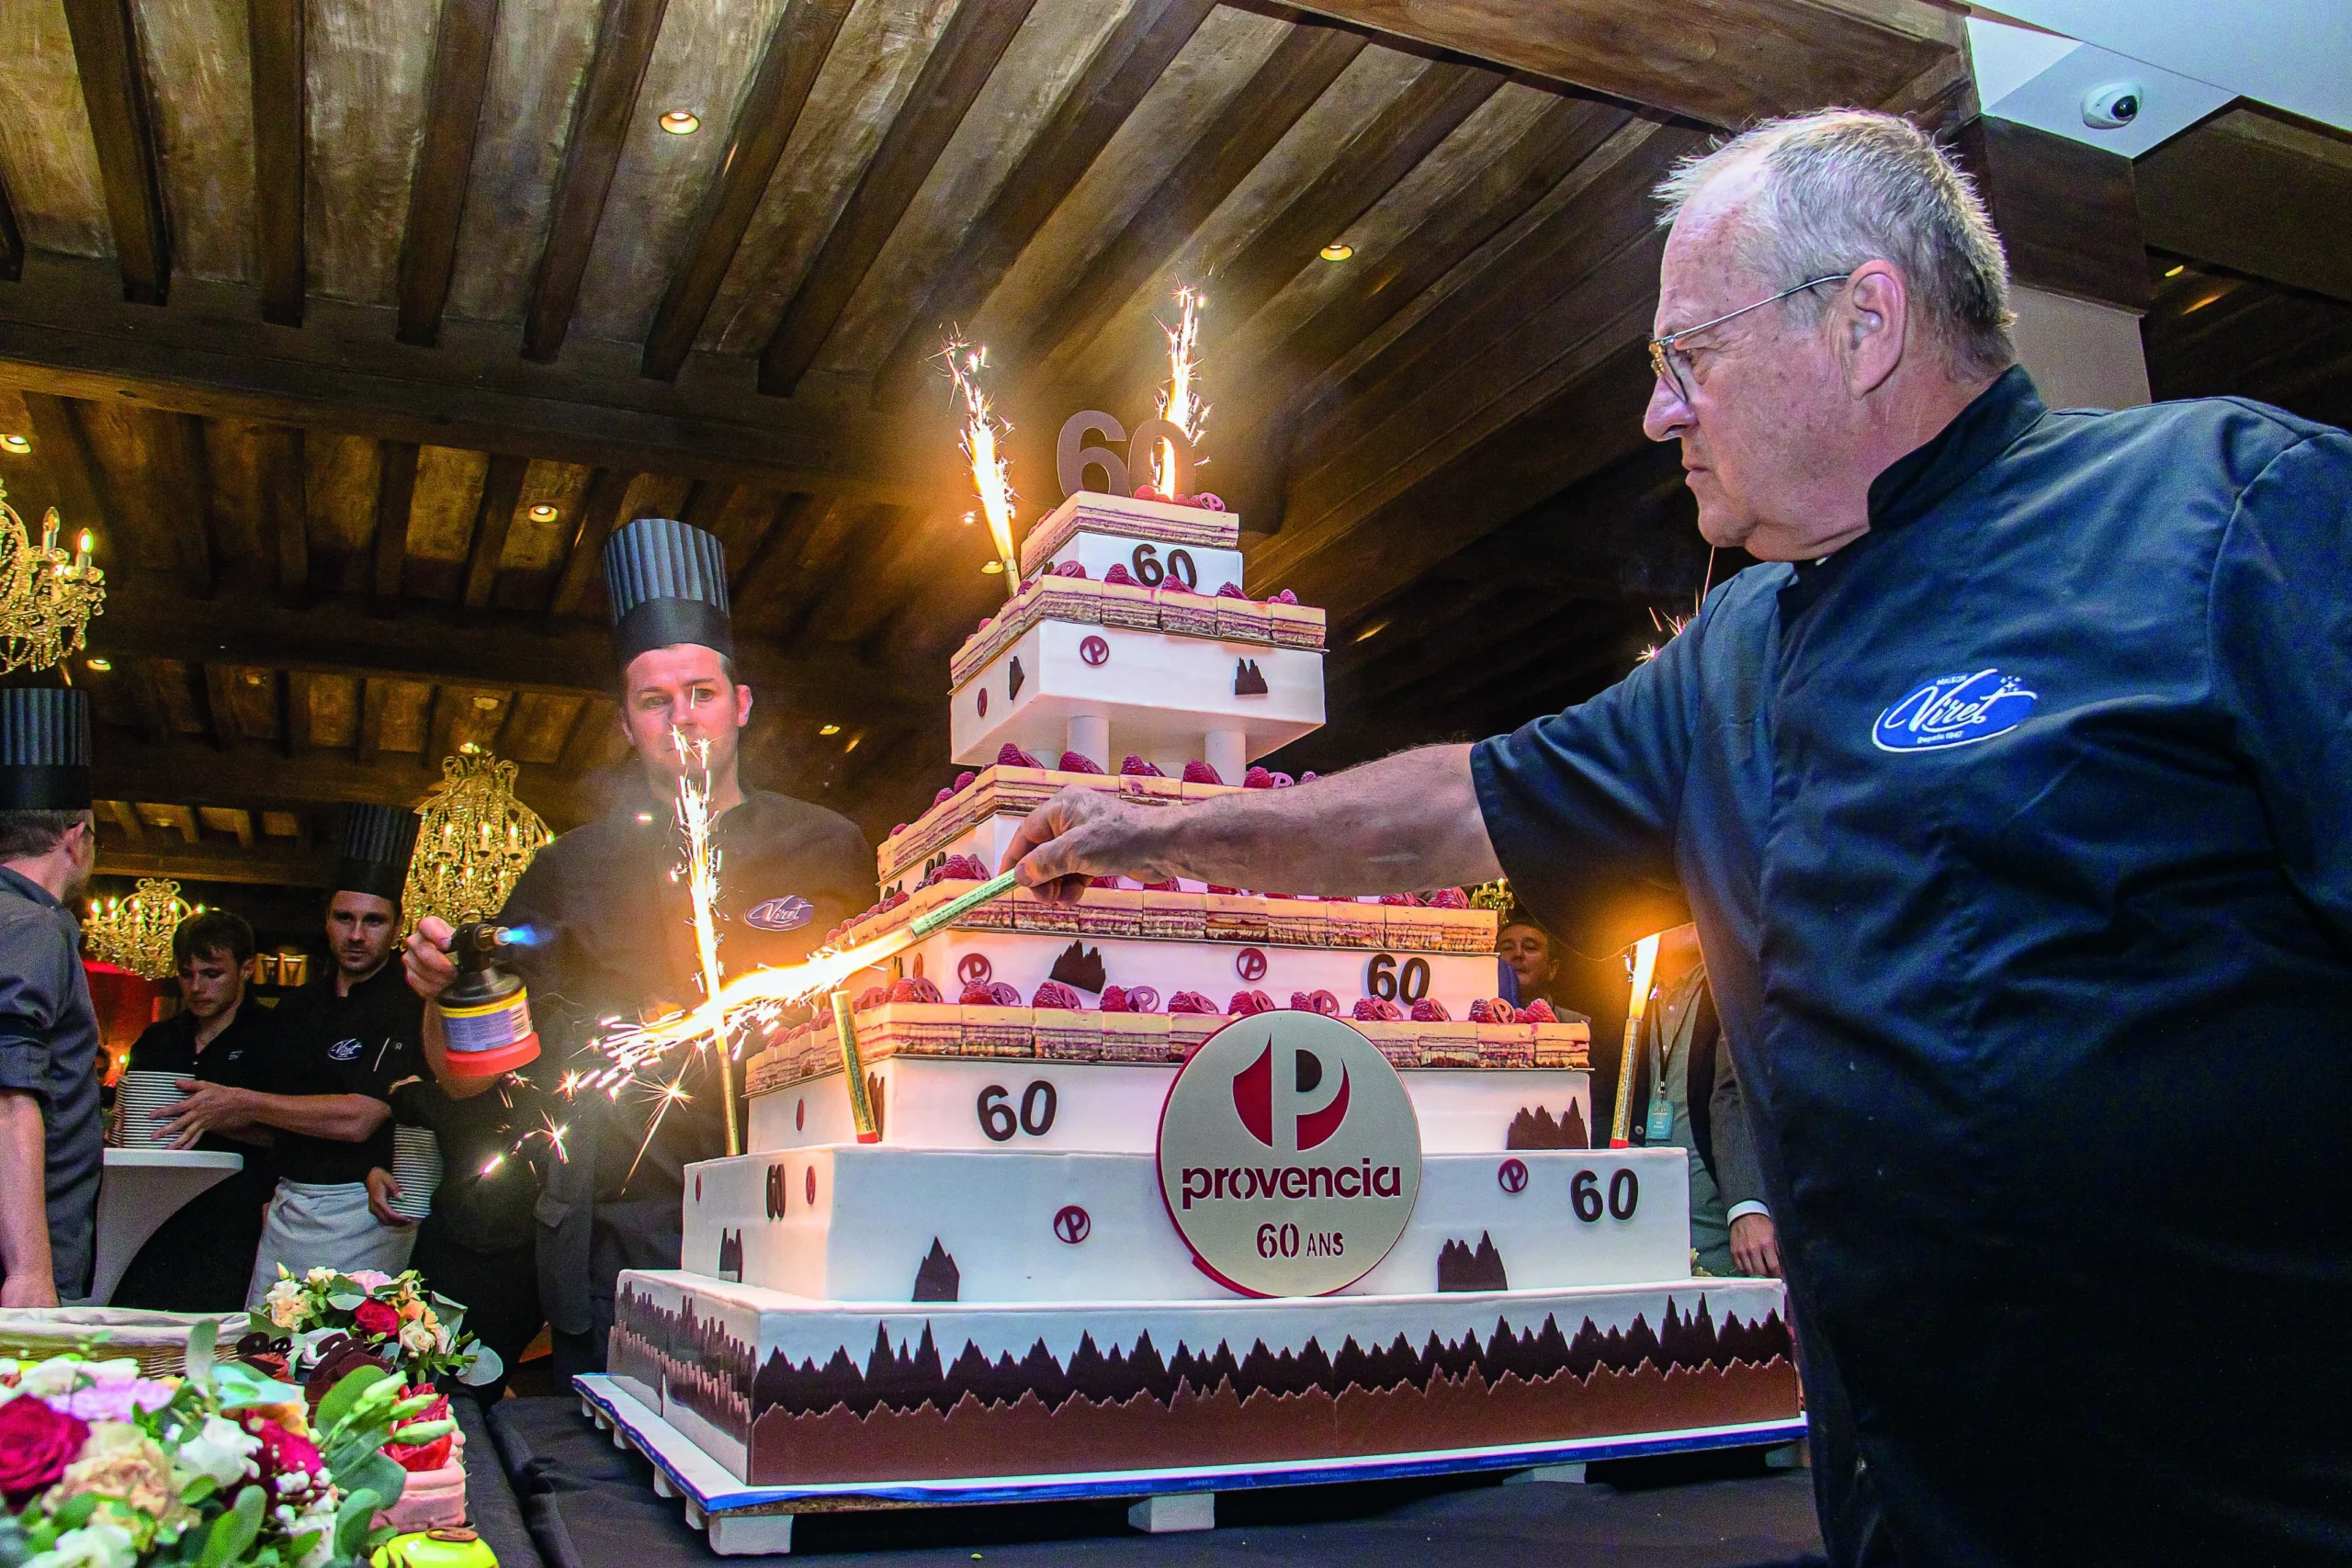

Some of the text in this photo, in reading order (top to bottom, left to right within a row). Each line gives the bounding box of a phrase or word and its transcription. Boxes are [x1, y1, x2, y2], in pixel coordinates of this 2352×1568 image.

[1057, 411, 1193, 499] 60
[1132, 544, 1197, 590] 60
[1883, 668, 2038, 733] Viret
[1367, 953, 1430, 1006] 60
[978, 1079, 1057, 1142] 60
[1182, 1157, 1401, 1210] provencia
[1571, 1168, 1639, 1223] 60
[1256, 1223, 1344, 1259] 60 ANS
